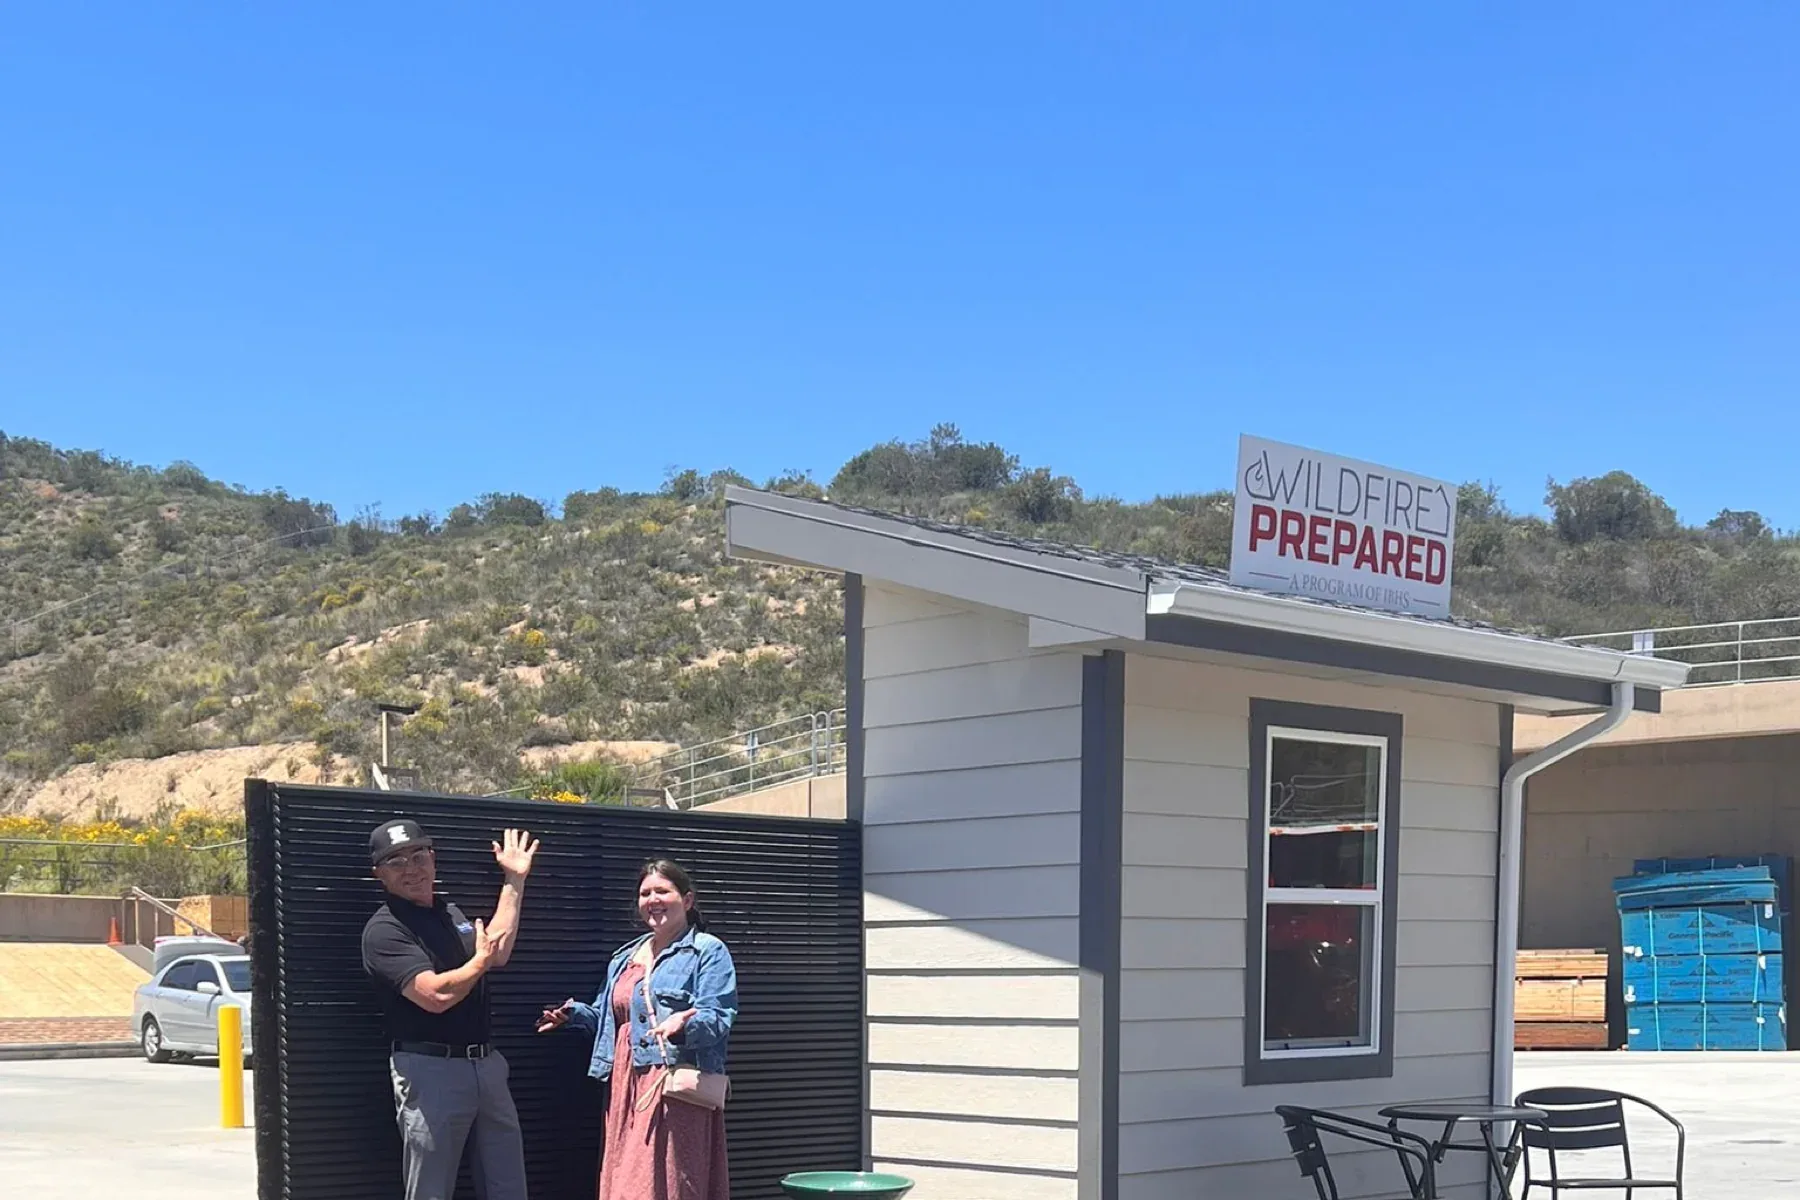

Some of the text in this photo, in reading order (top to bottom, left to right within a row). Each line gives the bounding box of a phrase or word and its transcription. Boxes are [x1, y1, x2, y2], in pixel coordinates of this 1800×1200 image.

[1262, 449, 1437, 535] WILDFIRE
[1248, 503, 1448, 586] PREPARED
[1289, 573, 1410, 609] A PROGRAM OF IBHS
